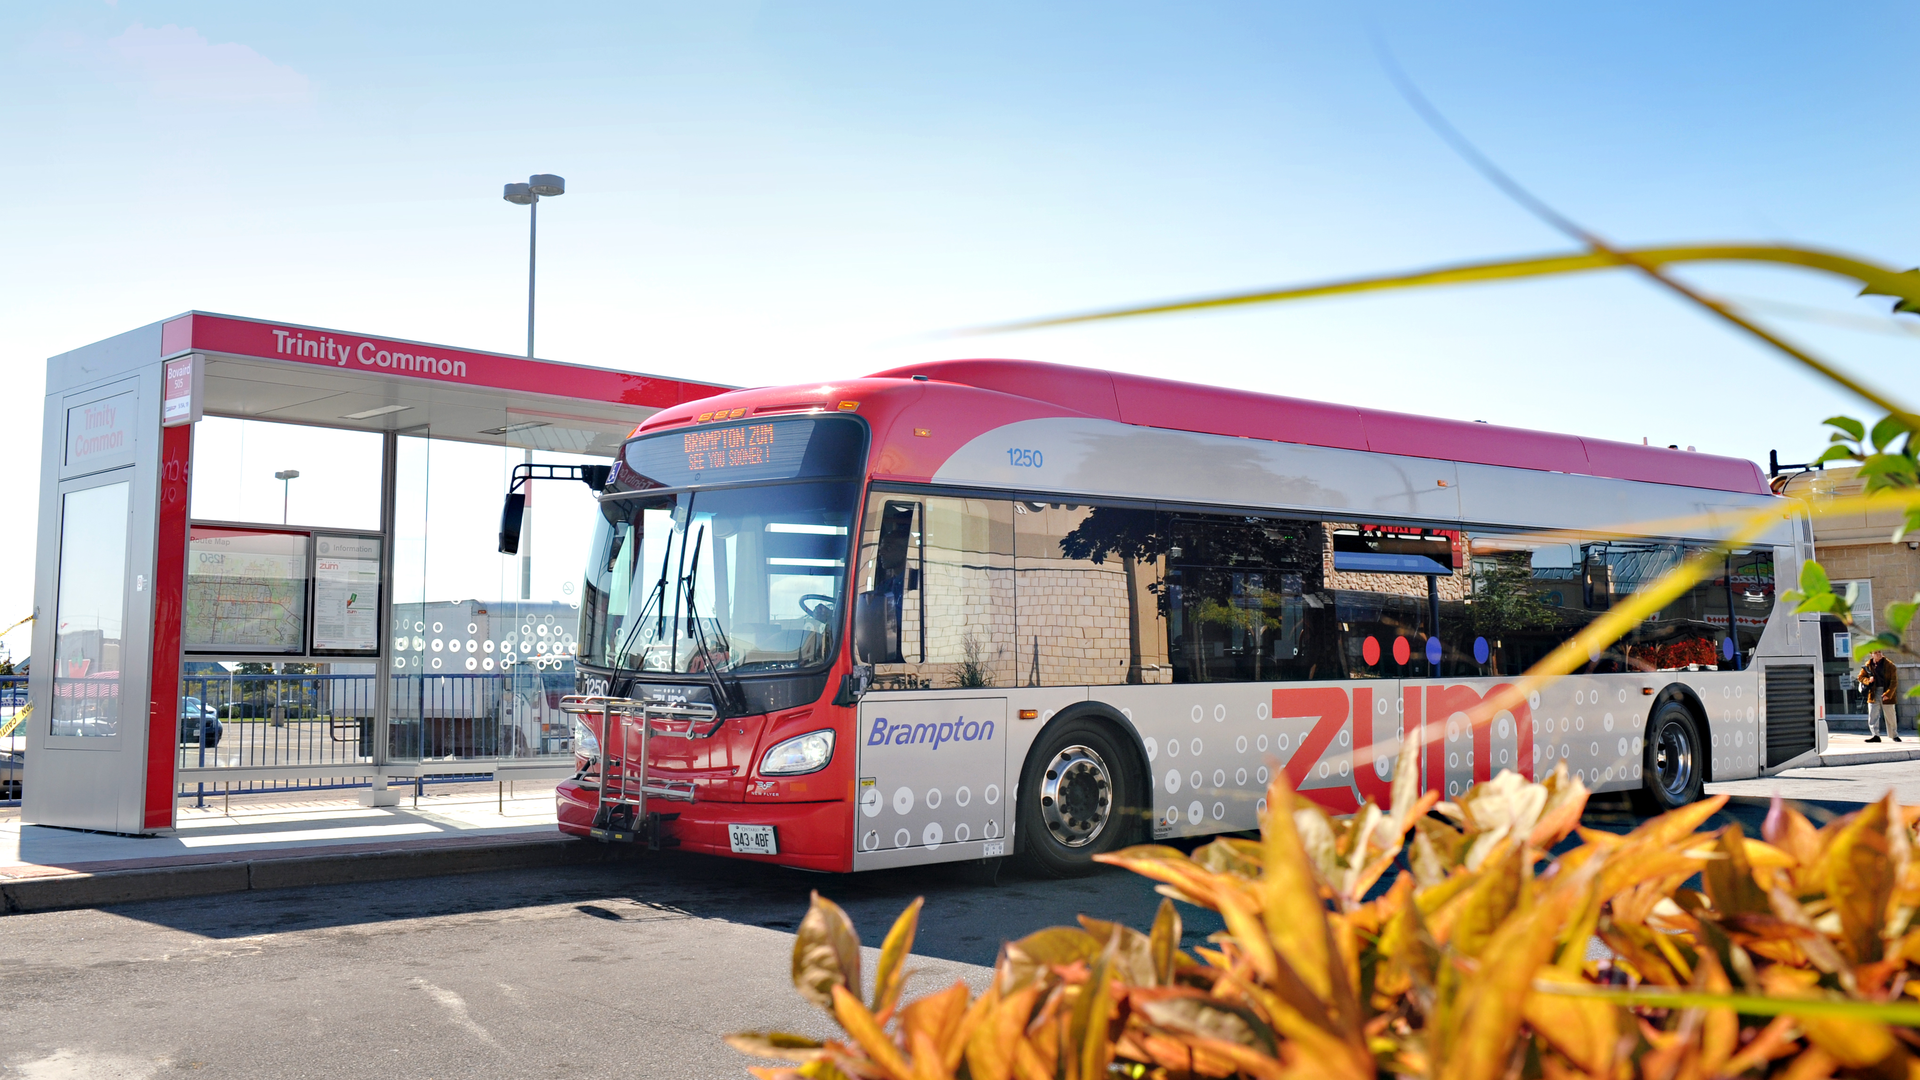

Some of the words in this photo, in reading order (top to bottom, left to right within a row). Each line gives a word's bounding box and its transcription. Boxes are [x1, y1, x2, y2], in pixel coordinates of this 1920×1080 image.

[272, 329, 351, 366] Trinity
[356, 341, 467, 377] Common
[168, 363, 191, 380] Bovaird
[174, 379, 184, 390] 505
[84, 404, 117, 430] Trinity
[75, 430, 124, 457] Common
[684, 427, 746, 453] BRAMPTON
[748, 423, 774, 446] ZUM
[688, 452, 705, 470] SEE
[707, 450, 726, 469] YOU
[1006, 447, 1043, 469] 1250
[214, 538, 231, 547] Map
[333, 544, 373, 554] Information
[585, 677, 609, 697] 1250
[867, 716, 995, 751] Brampton
